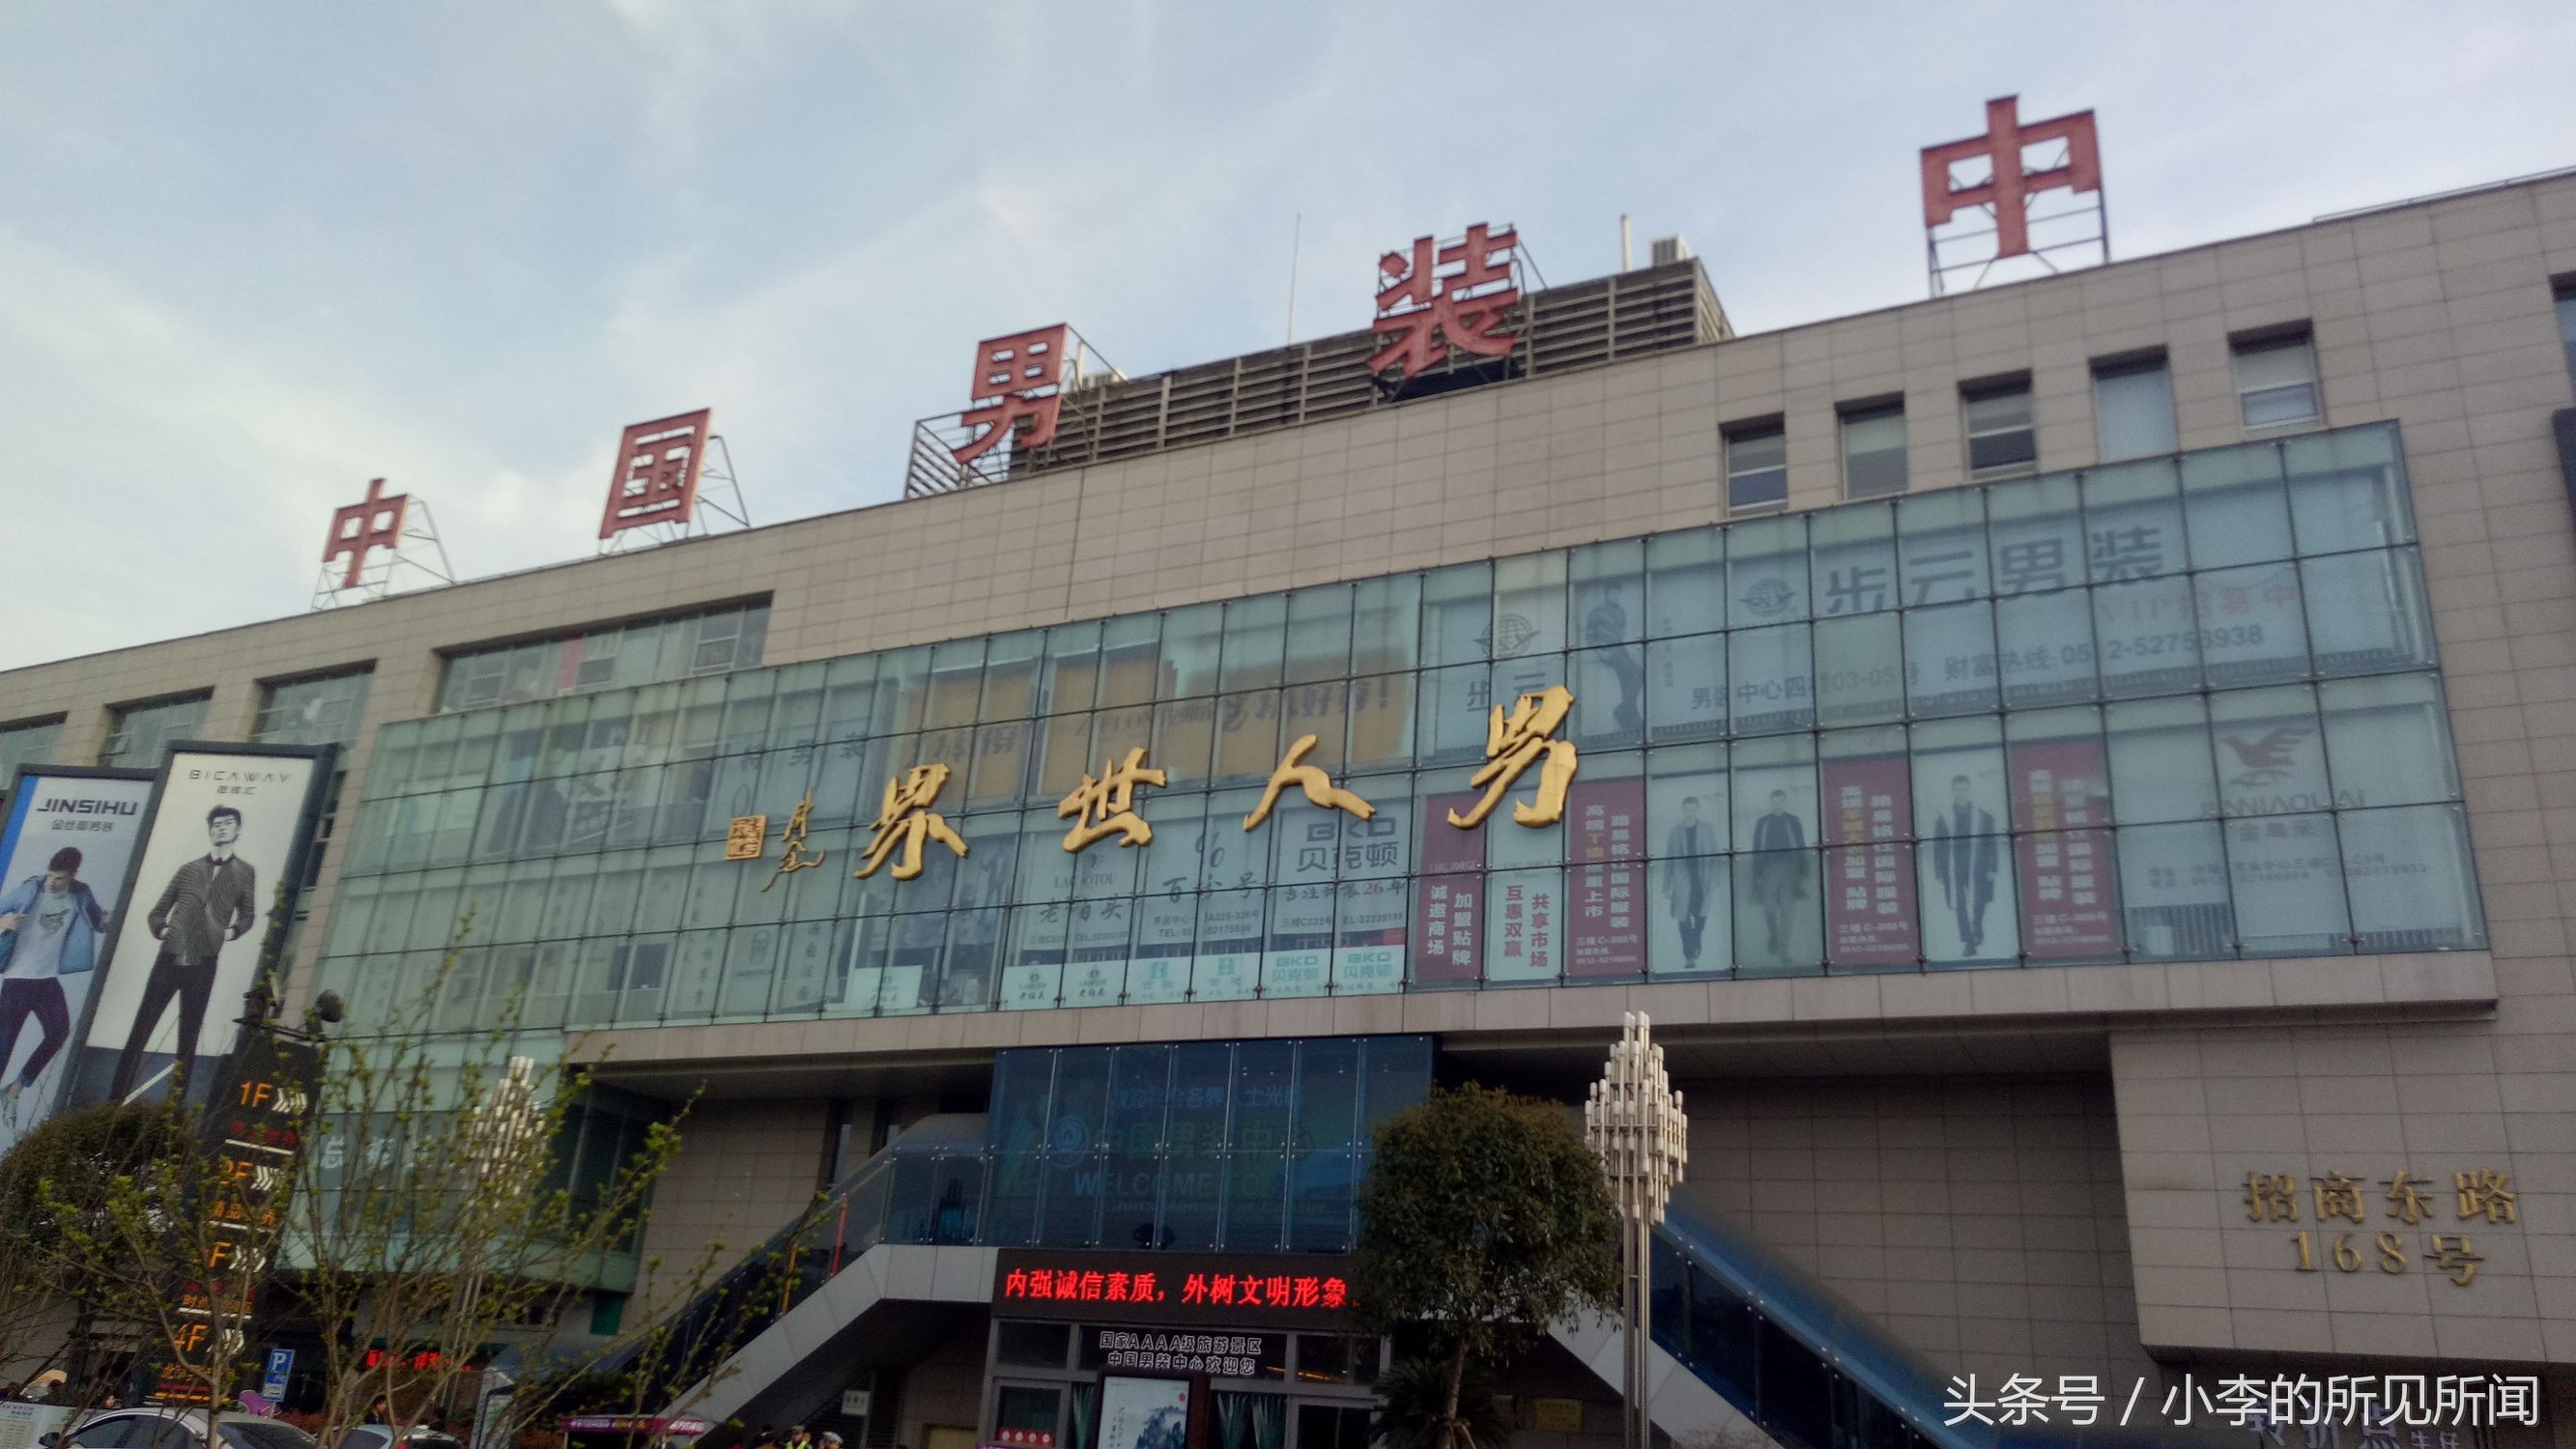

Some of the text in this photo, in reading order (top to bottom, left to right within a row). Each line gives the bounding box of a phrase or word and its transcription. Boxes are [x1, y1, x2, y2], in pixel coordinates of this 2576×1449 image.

[189, 769, 293, 783] BICAWAY
[37, 798, 138, 816] JINSIHU
[1296, 840, 1400, 872] 贝克顿
[1451, 893, 1474, 966] 加盟贴牌
[1503, 884, 1524, 957] 互惠双赢
[1530, 893, 1550, 968] 共享市场
[241, 1081, 273, 1108] 1F
[1073, 1171, 1215, 1198] WELCOME
[2242, 1169, 2516, 1225] 招商东路
[2292, 1231, 2484, 1287] 168号
[1099, 1330, 1262, 1355] 国家AAAA级旅游景区
[1107, 1350, 1256, 1376] 中国男装中心欢迎您
